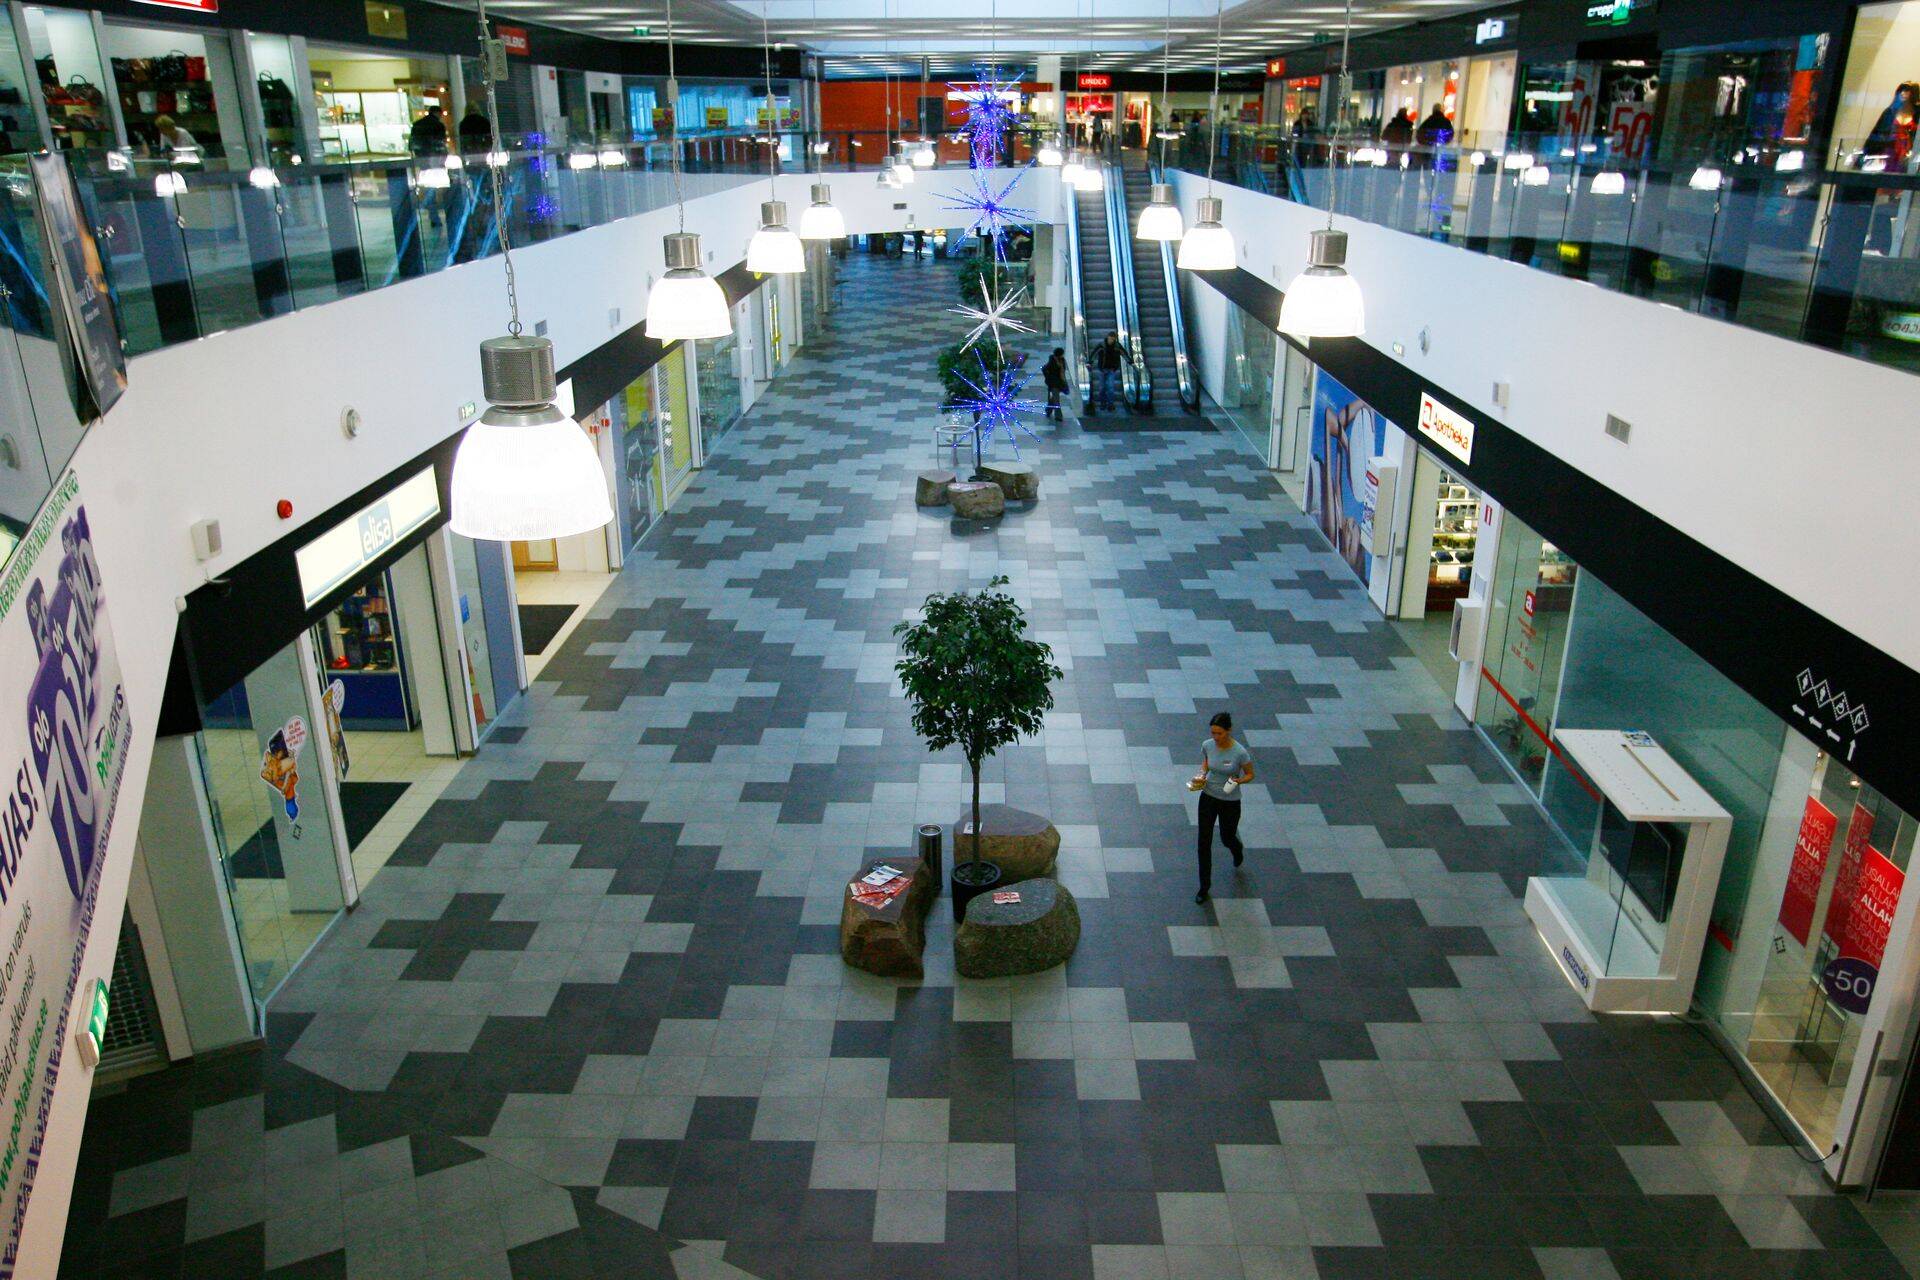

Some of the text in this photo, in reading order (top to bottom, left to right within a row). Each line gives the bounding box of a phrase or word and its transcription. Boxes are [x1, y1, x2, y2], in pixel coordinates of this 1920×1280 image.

[1081, 78, 1108, 86] LINDEX
[363, 514, 393, 554] elisa
[44, 688, 95, 902] 70
[1860, 893, 1893, 927] ALLAH
[6, 952, 17, 982] on
[13, 899, 32, 955] varuks
[1826, 970, 1871, 998] -50
